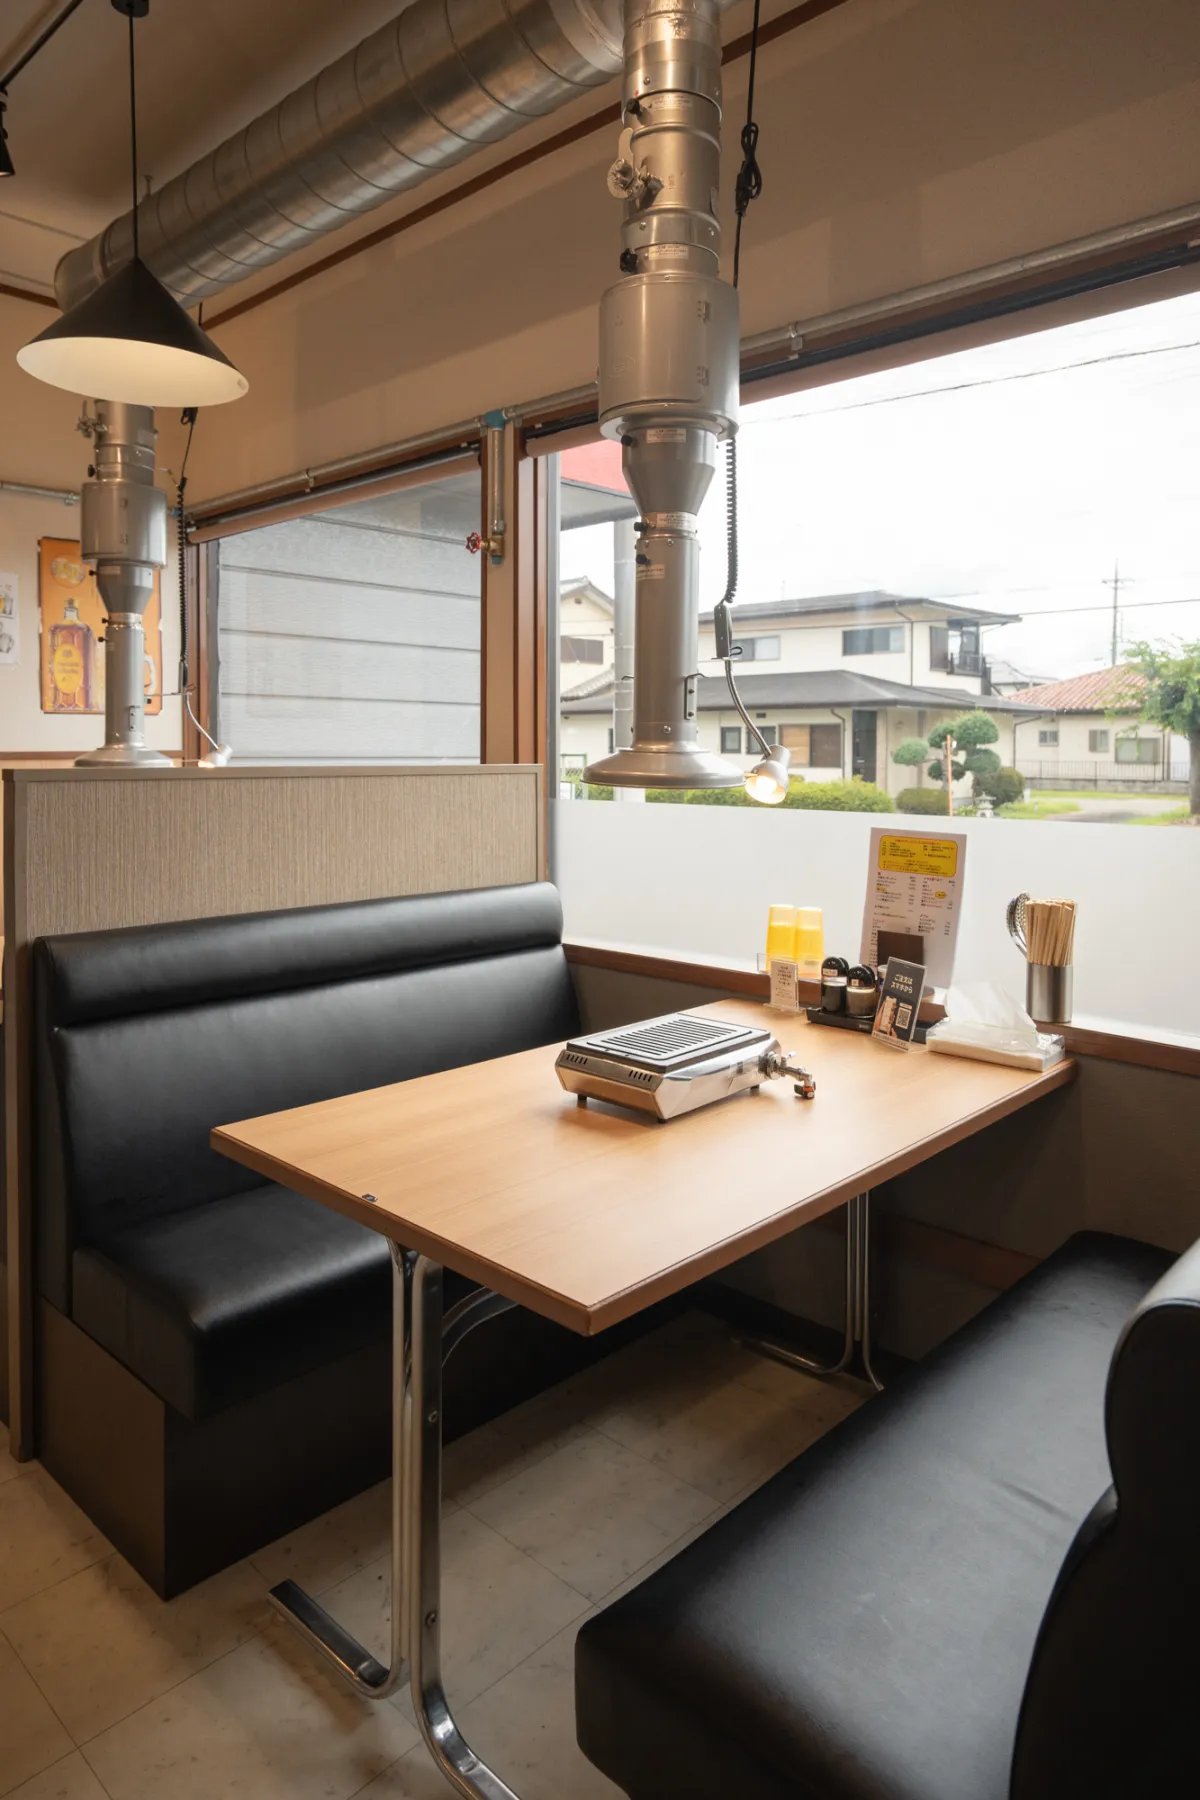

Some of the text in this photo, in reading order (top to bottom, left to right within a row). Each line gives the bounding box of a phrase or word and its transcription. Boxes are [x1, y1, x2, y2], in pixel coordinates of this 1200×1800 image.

[894, 974, 913, 985] ご注文は
[890, 981, 913, 994] スマホから
